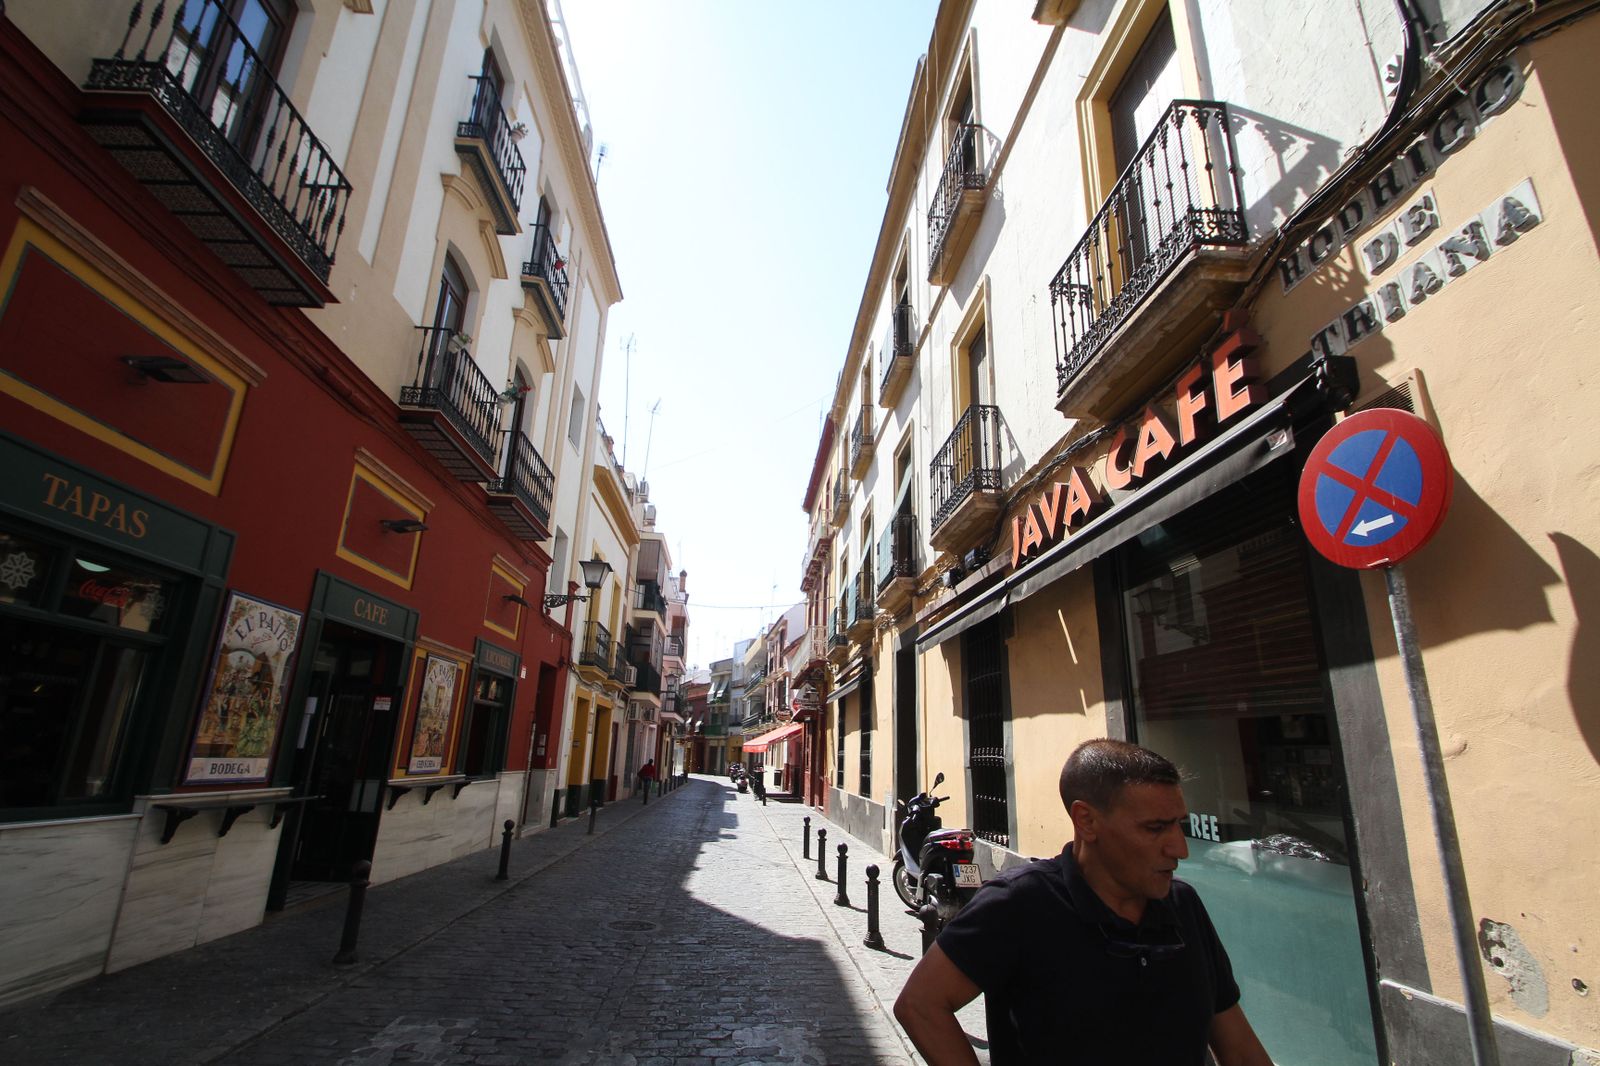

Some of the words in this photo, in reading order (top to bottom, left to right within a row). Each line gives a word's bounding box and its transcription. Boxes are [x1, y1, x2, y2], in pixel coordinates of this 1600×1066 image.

[1362, 195, 1441, 276] DE
[1311, 195, 1540, 357] TRIANA
[41, 472, 150, 540] TAPAS
[1010, 466, 1096, 569] JAVA
[235, 616, 254, 641] EL
[259, 611, 288, 651] PATIO
[209, 763, 251, 775] BODEGA
[960, 865, 977, 874] 4237
